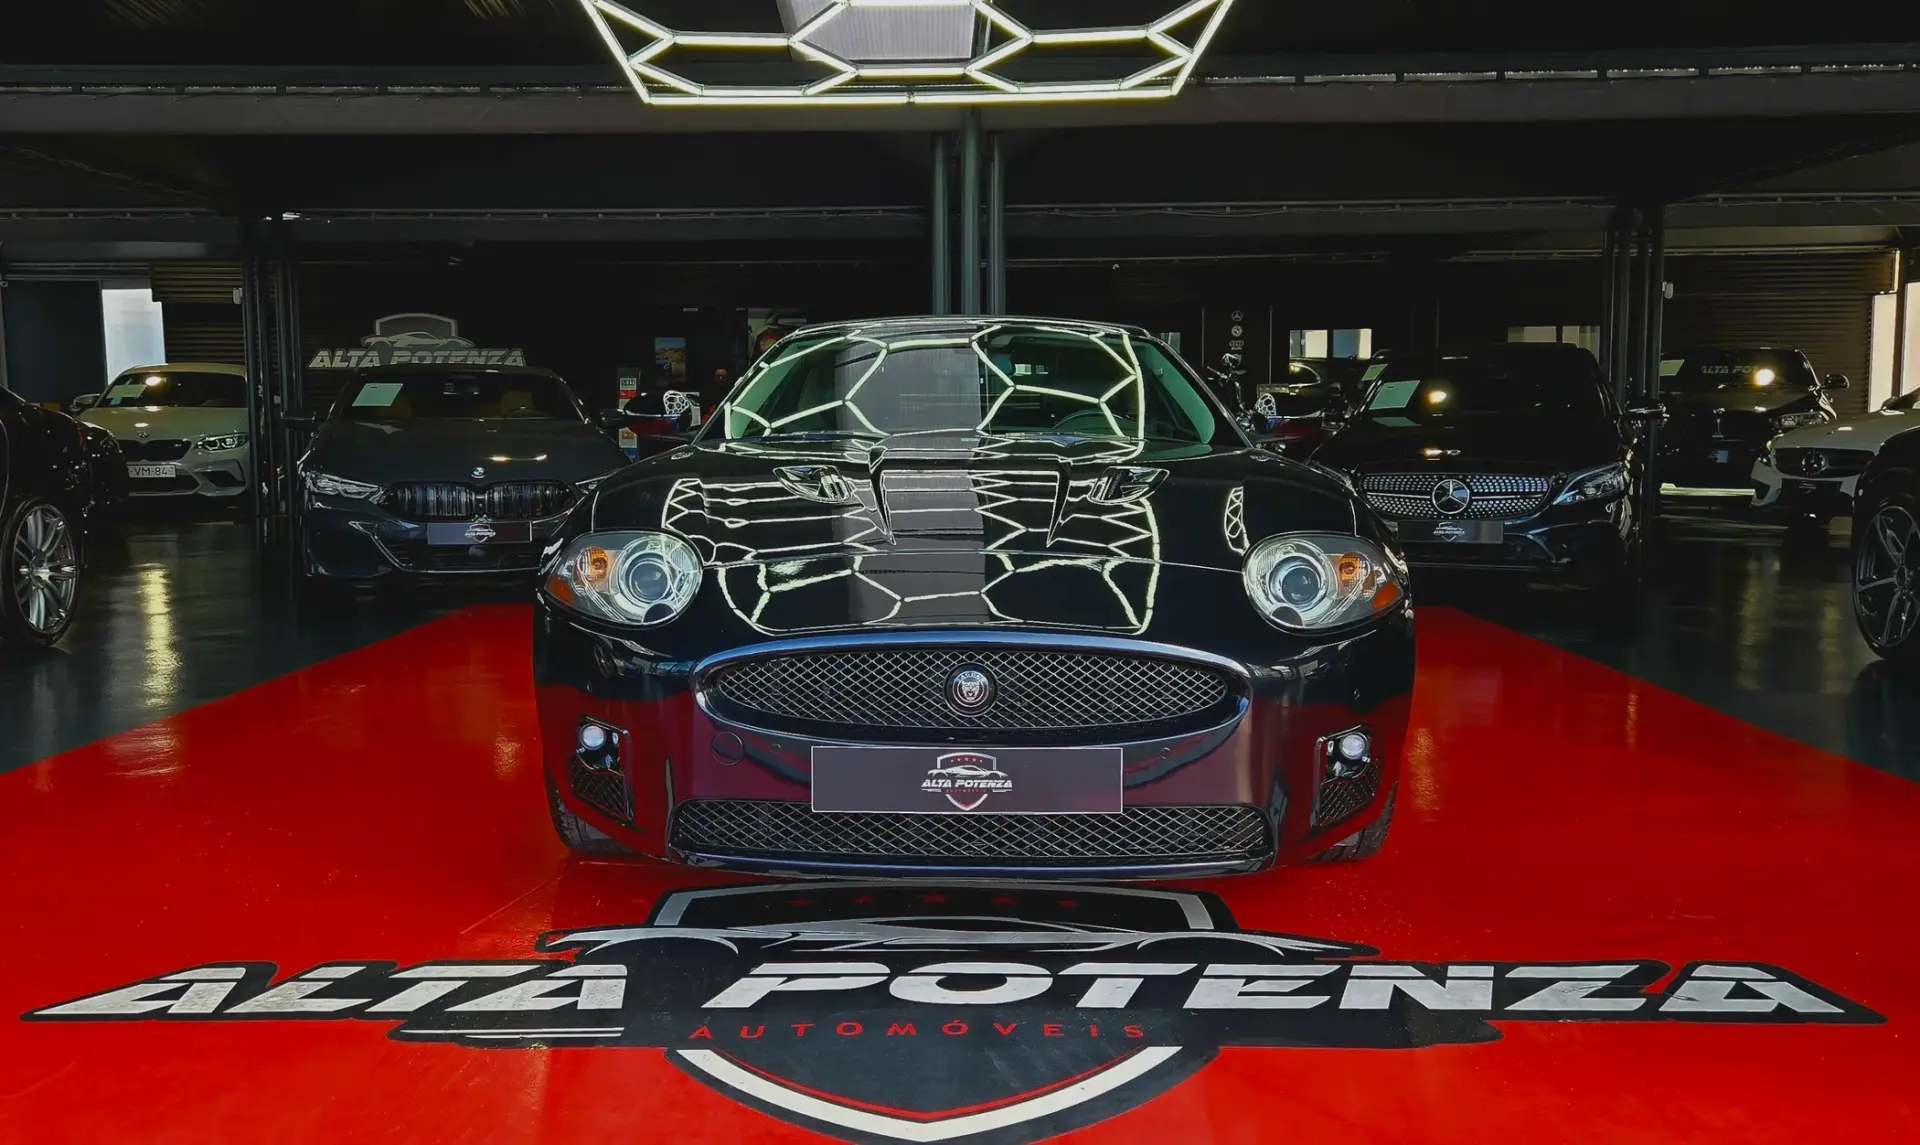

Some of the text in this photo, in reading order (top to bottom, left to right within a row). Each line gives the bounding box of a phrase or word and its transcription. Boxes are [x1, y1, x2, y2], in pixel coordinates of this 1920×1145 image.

[308, 349, 524, 368] ALTA POTENZA
[130, 467, 167, 476] -VM-84
[921, 779, 1012, 788] ALTA POTENZA
[35, 962, 1844, 1015] ALTA POTENZA
[689, 1020, 1144, 1040] AUTOMÓVEIS
